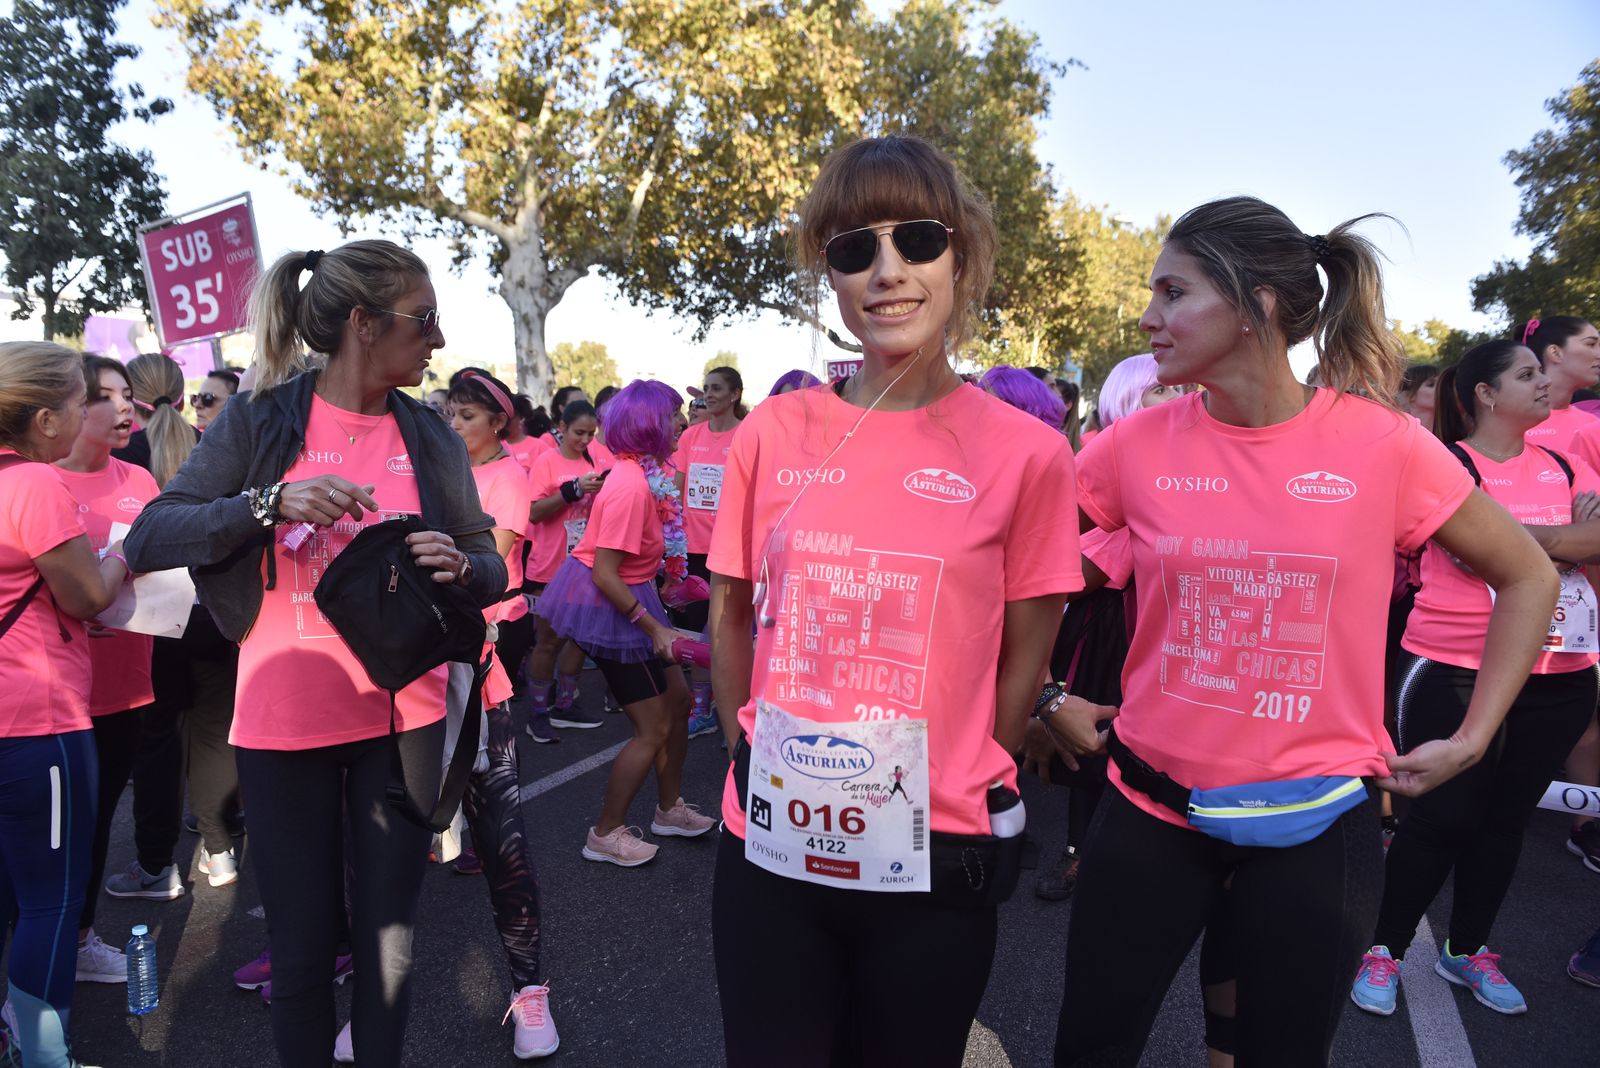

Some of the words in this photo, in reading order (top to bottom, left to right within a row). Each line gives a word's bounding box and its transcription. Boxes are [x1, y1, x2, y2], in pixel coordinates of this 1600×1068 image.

[161, 230, 213, 272] SUB
[829, 362, 857, 378] SUB
[300, 450, 343, 464] YSHO
[777, 468, 846, 486] OYSHO
[1155, 476, 1228, 492] OYSHO
[698, 485, 718, 495] 016
[908, 475, 970, 499] ASTURIANA
[1291, 481, 1351, 497] ASTURIANA
[792, 529, 854, 557] GANAN
[1191, 537, 1249, 560] GANAN
[807, 563, 855, 583] VITORIA
[867, 571, 918, 591] GASTEIZ
[1208, 567, 1255, 583] VITORIA
[1267, 571, 1317, 588] GASTEIZ
[830, 582, 882, 601] MADRID
[1233, 582, 1281, 599] MADRID
[827, 636, 856, 657] LAS
[1231, 630, 1259, 648] LAS
[1236, 651, 1318, 684] CHICAS
[832, 660, 917, 701] CHICAS
[1252, 690, 1312, 723] 2019
[785, 744, 867, 770] ASTURIANA
[841, 780, 880, 792] Carrera
[864, 791, 893, 809] Mujer
[788, 799, 866, 835] 016
[752, 840, 788, 863] OYSHO
[806, 836, 846, 854] 4122
[820, 863, 853, 874] Santander
[880, 876, 914, 884] ZURICH
